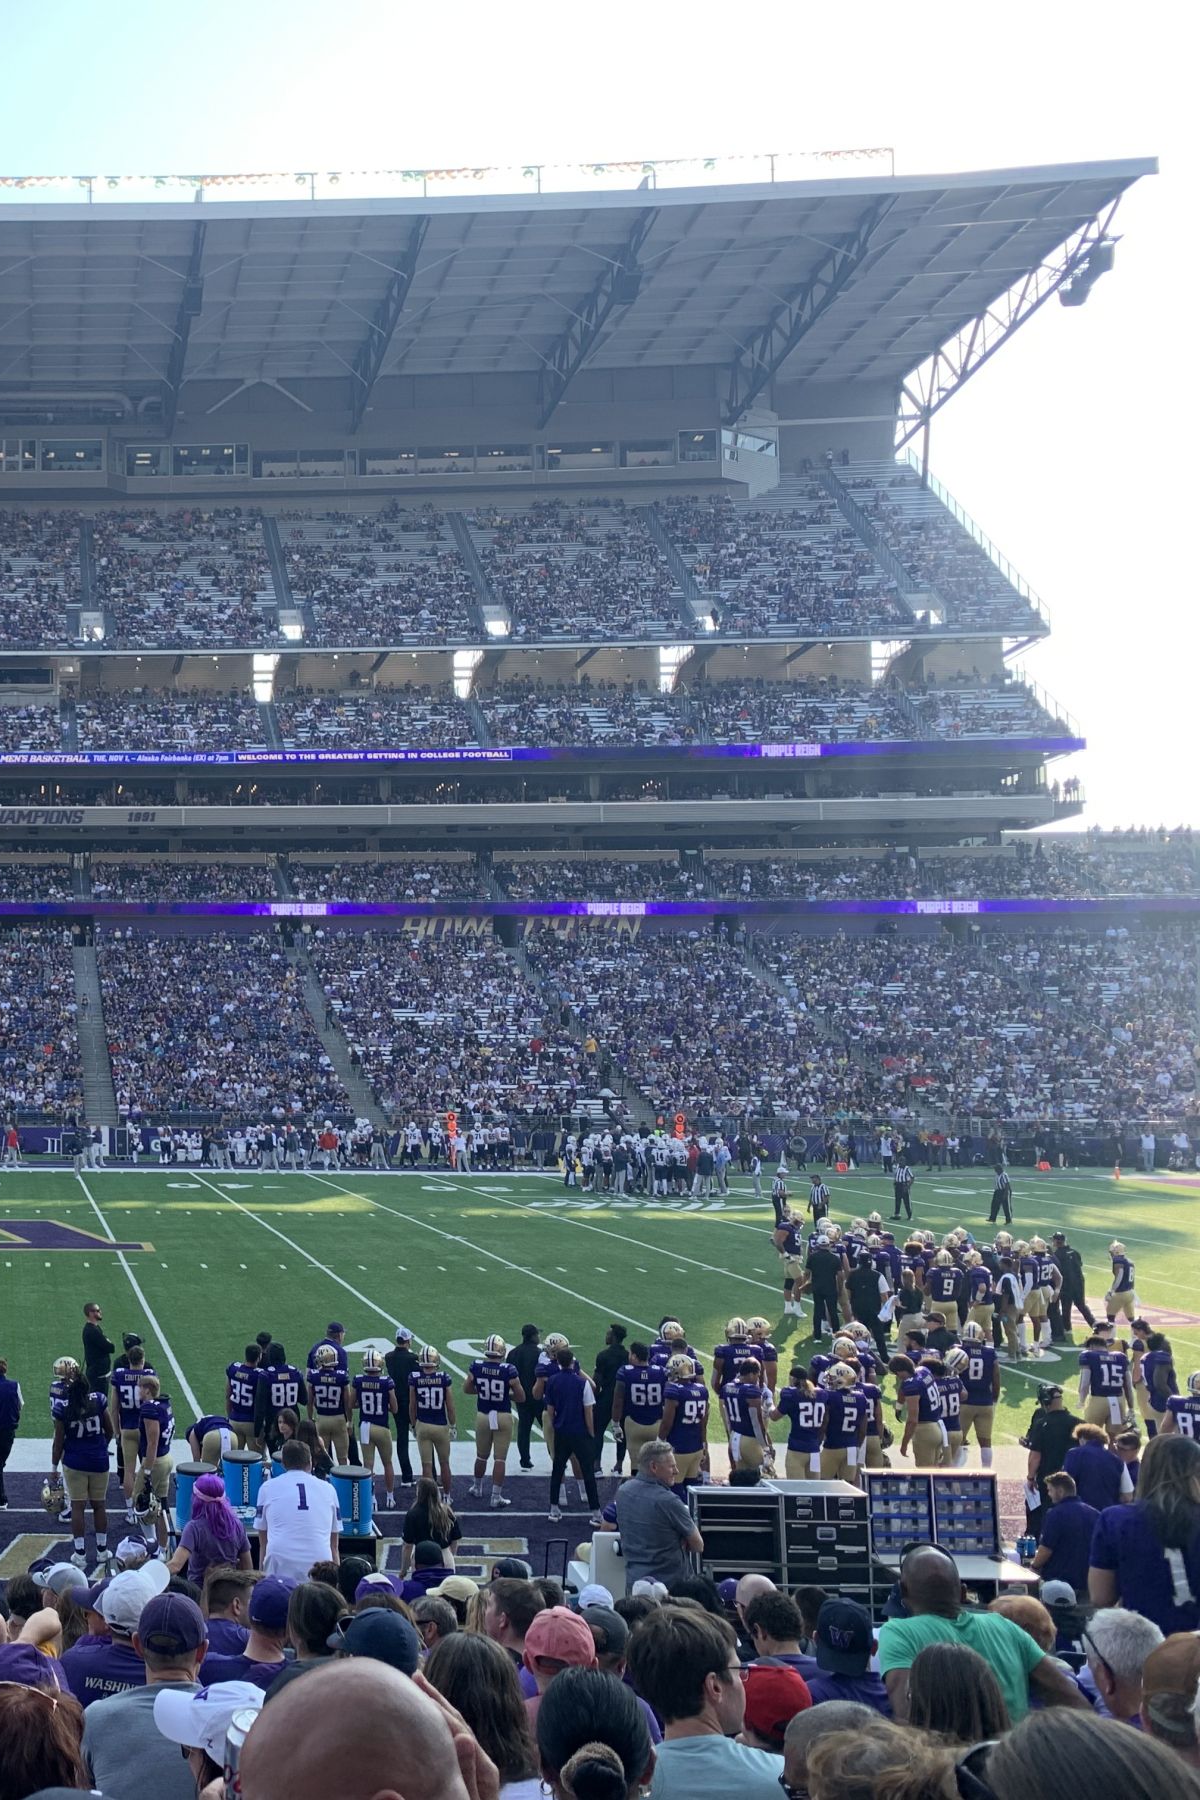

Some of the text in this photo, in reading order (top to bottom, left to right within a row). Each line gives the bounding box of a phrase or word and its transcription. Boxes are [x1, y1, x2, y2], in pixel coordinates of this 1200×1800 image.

[0, 754, 90, 763] MEN'S BASKETBALL
[108, 754, 124, 762] NOV
[137, 754, 159, 762] Alaska
[160, 754, 192, 762] Fairbanks
[238, 750, 510, 761] WELCOME TO THE GREATEST SETTING IN COLLEGE FOOTBALL
[762, 744, 794, 756] PURPLE
[587, 903, 619, 915] PURPLE
[917, 901, 952, 913] PURPLE
[942, 1278, 955, 1296] 9
[968, 1357, 984, 1380] 8
[1100, 1363, 1124, 1388] 15
[230, 1378, 254, 1408] 35
[271, 1382, 299, 1407] 88
[314, 1384, 342, 1409] 29
[417, 1386, 444, 1410] 30
[476, 1377, 505, 1401] 39
[630, 1382, 662, 1406] 68
[361, 1391, 384, 1416] 81
[726, 1396, 742, 1423] 11
[798, 1402, 826, 1428] 20
[69, 1415, 101, 1438] 79
[841, 1407, 858, 1432] 2
[296, 1482, 309, 1511] 1
